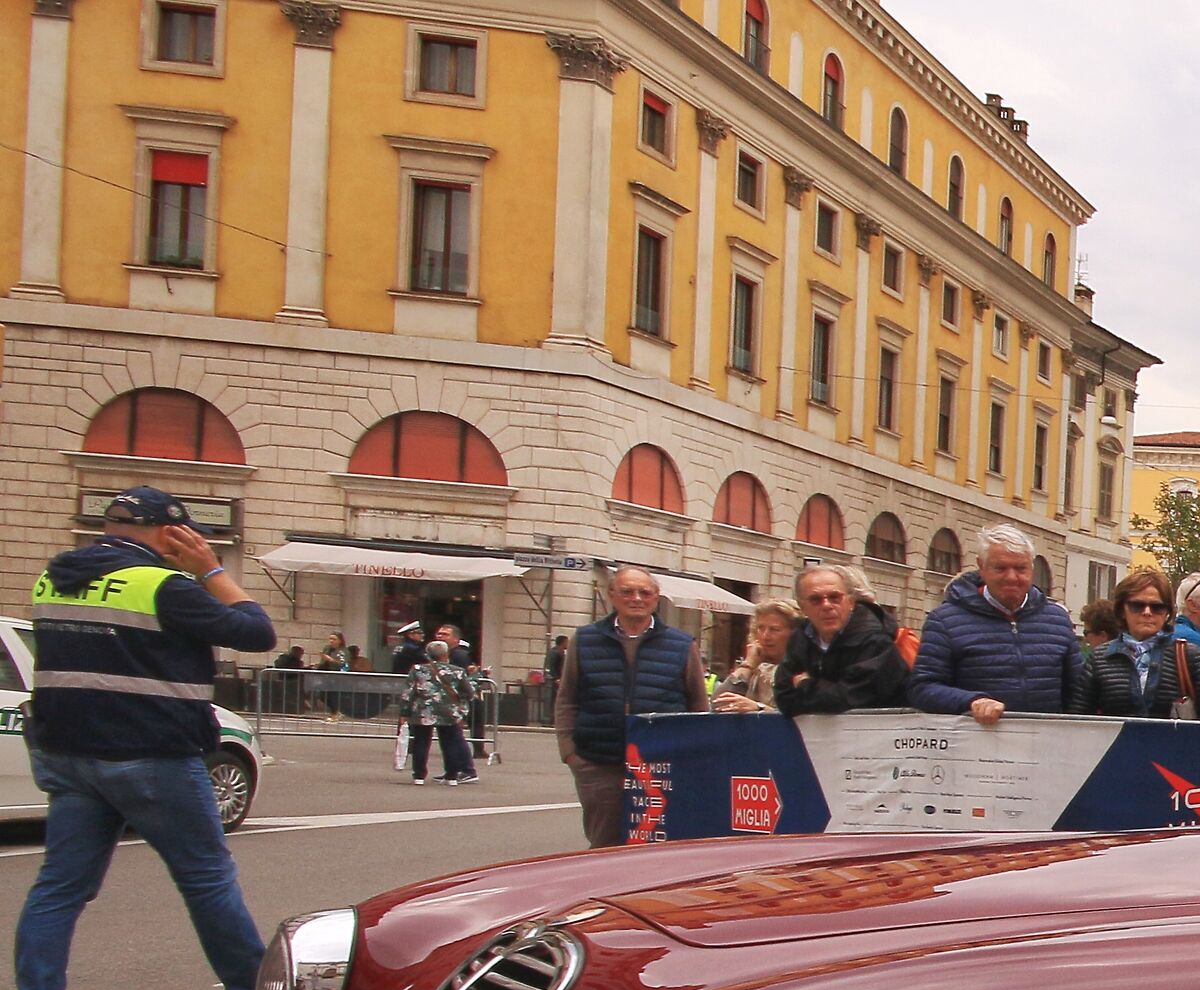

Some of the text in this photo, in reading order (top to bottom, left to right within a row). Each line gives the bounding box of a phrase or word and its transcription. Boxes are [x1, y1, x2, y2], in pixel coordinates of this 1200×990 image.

[353, 563, 425, 578] TINELLO
[36, 572, 128, 602] SFF
[894, 738, 949, 751] CHOPARD
[736, 783, 769, 802] 1000
[735, 808, 771, 827] MIGLIA
